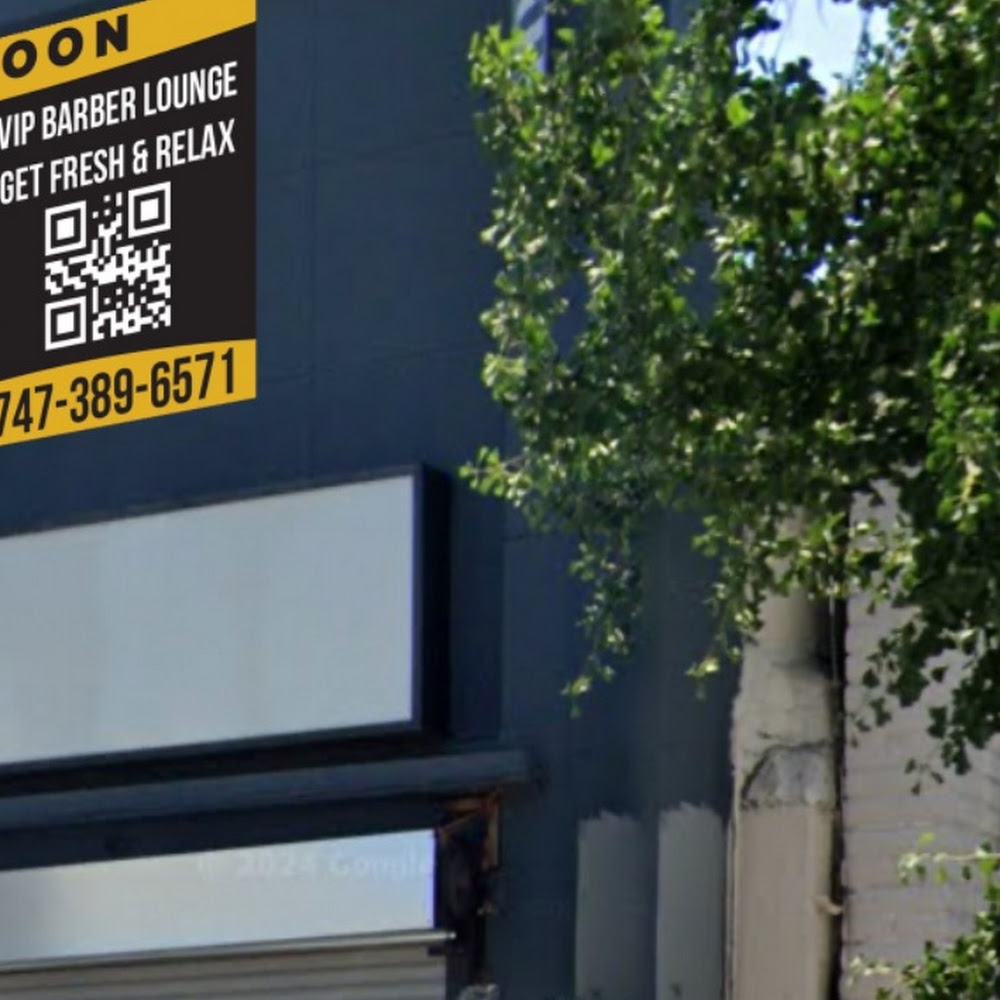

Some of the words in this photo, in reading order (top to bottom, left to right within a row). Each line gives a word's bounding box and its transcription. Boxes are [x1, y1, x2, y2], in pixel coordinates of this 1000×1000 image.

[42, 87, 136, 140] BARBER
[143, 60, 238, 117] LOUNGE
[50, 144, 125, 194] FRESH
[132, 139, 149, 175] &
[156, 118, 236, 170] RELAX
